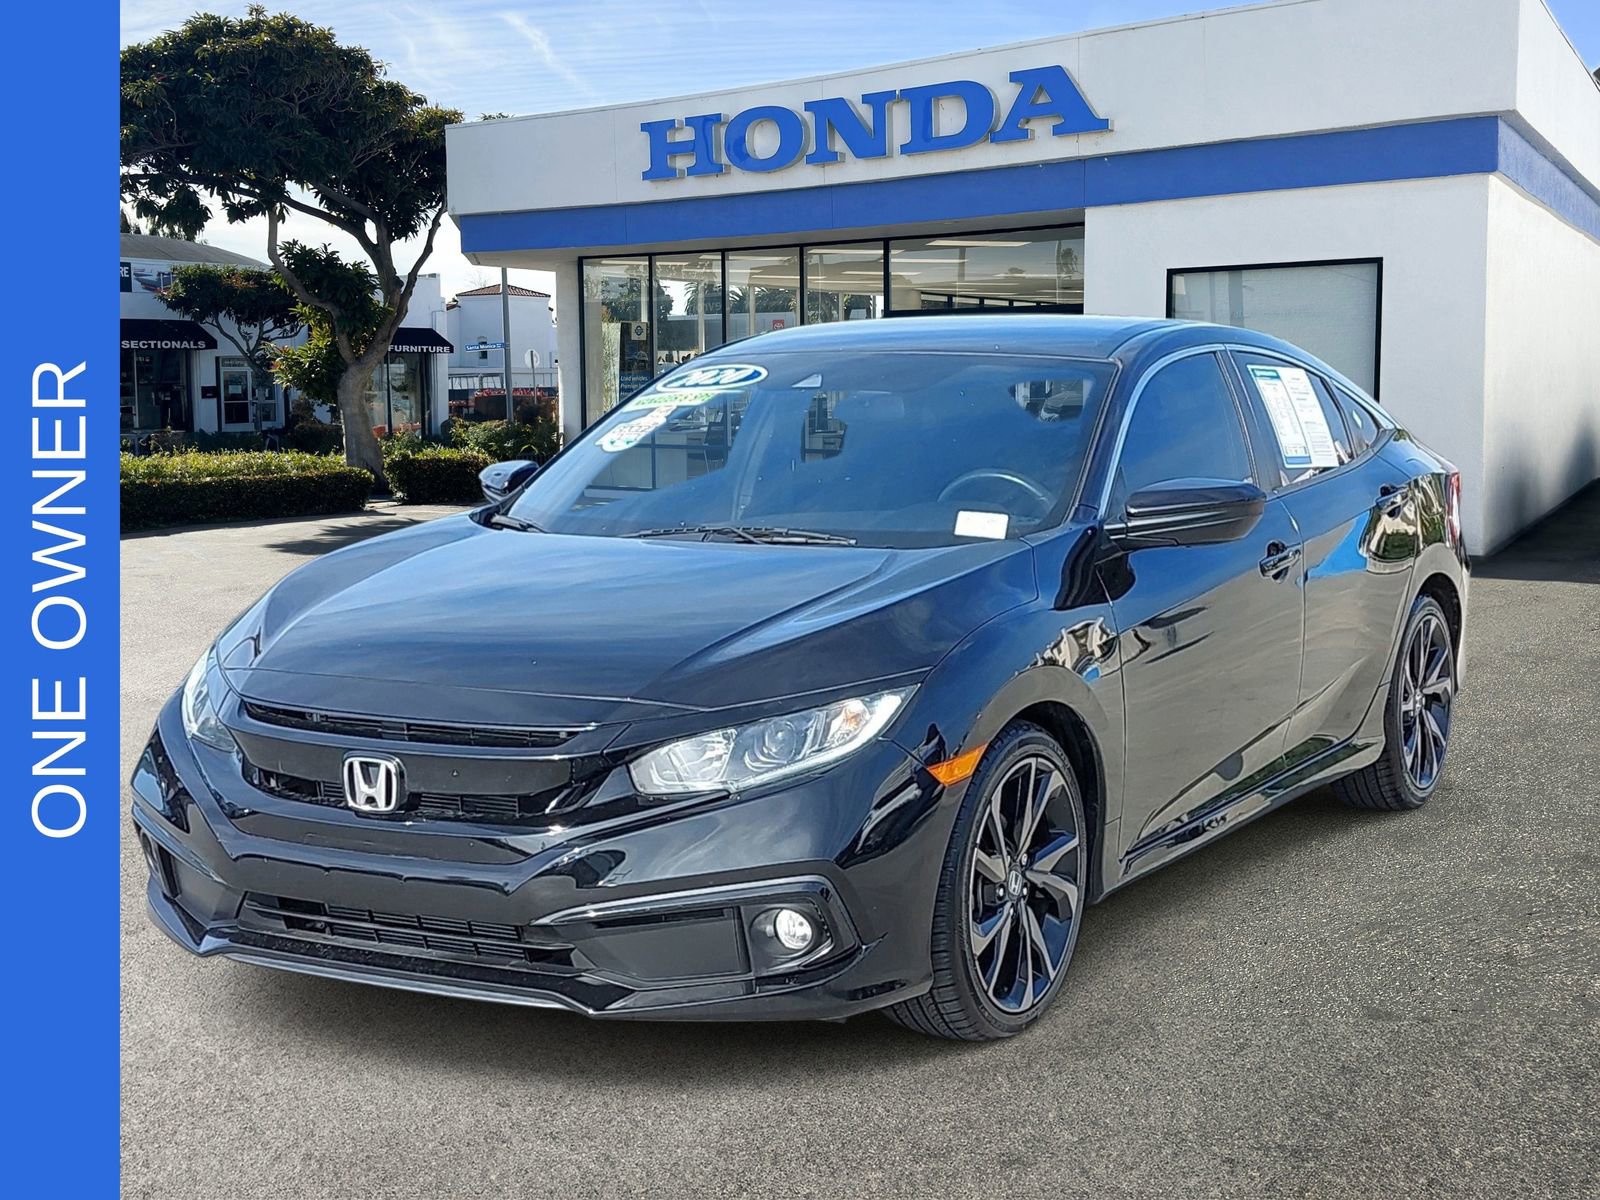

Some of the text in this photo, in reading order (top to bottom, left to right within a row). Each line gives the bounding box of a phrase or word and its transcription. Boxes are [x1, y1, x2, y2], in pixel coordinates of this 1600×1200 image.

[640, 64, 1111, 182] HONDA
[121, 340, 206, 349] SECTIONALS
[388, 344, 450, 353] FURNITURE
